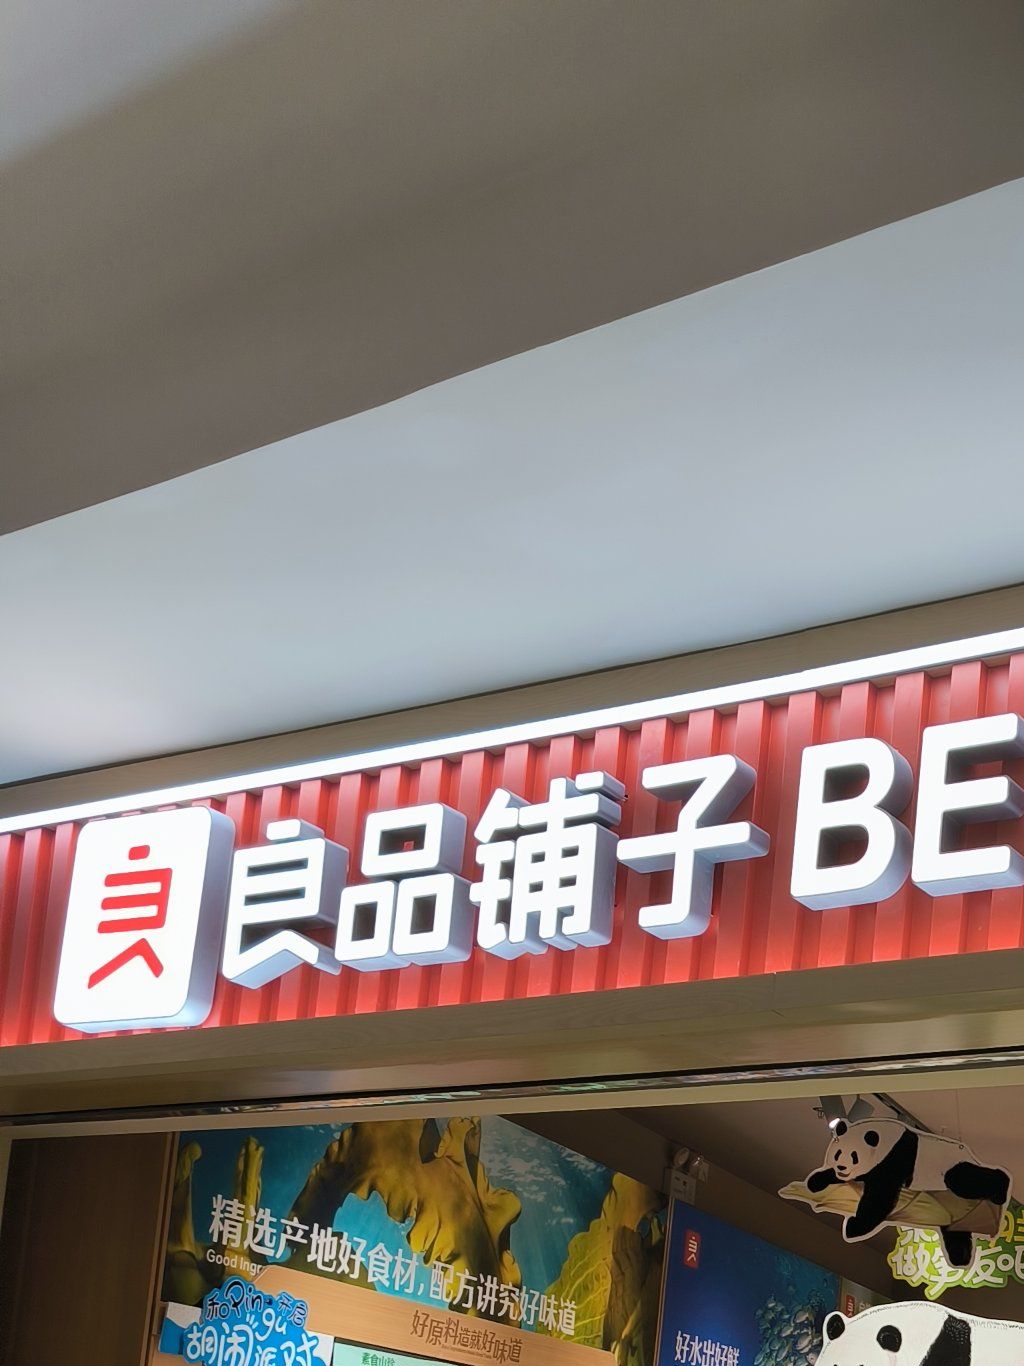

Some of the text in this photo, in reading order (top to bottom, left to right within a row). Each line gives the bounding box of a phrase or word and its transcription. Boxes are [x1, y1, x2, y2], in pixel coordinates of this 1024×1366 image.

[220, 752, 770, 990] 良品铺子
[206, 1248, 238, 1269] Good
[409, 1309, 524, 1364] 好原料造就好味道
